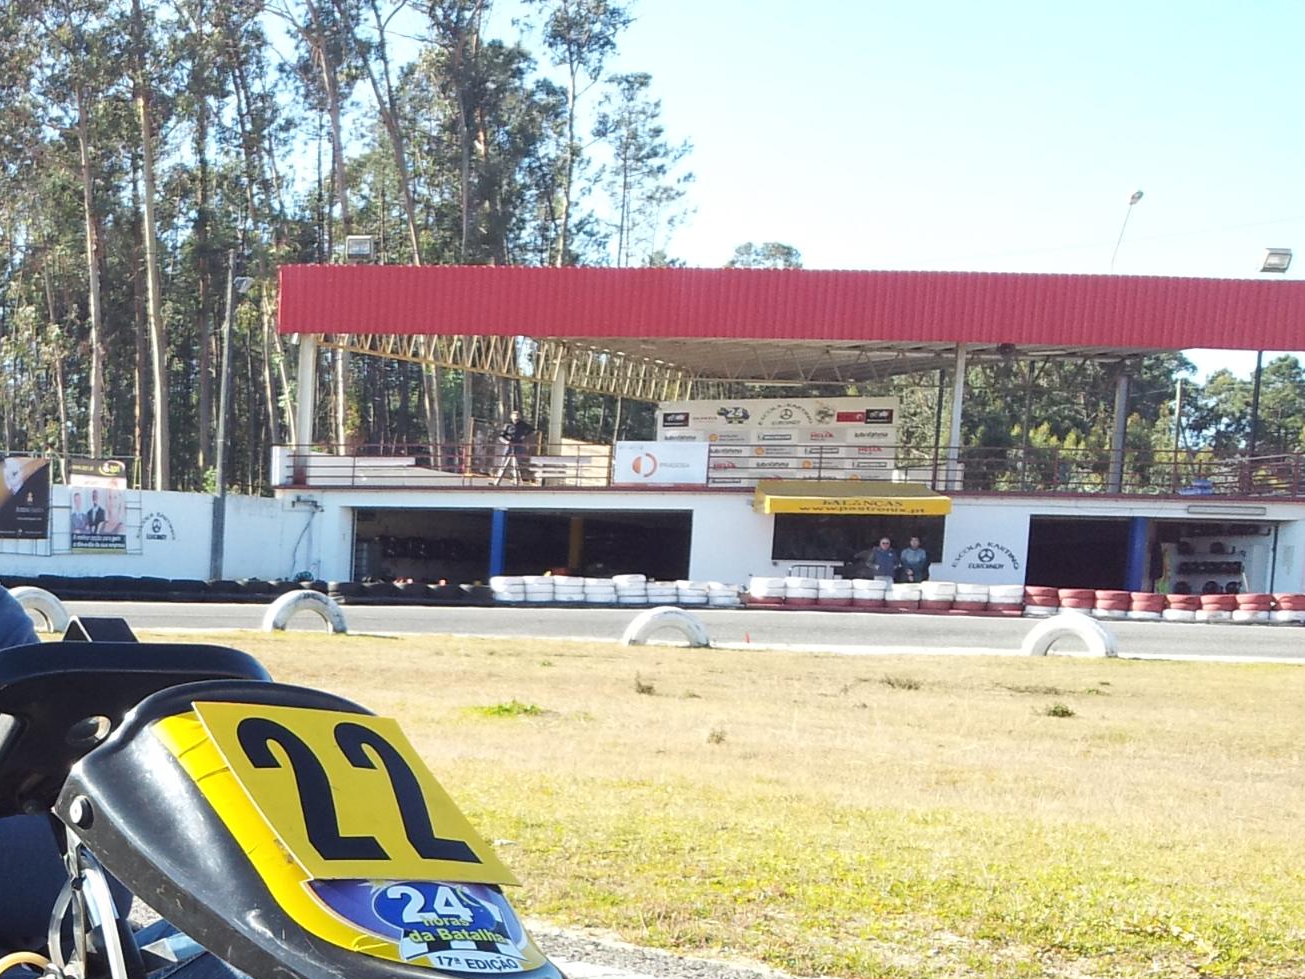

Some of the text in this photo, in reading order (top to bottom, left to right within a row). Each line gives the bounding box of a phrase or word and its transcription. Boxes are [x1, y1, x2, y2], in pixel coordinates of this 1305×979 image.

[728, 408, 743, 418] 24
[237, 716, 484, 863] 22
[386, 885, 473, 924] 24
[421, 914, 471, 928] horas
[408, 927, 509, 945] da Batalha
[435, 954, 519, 972] 17ª EDIÇÃO
